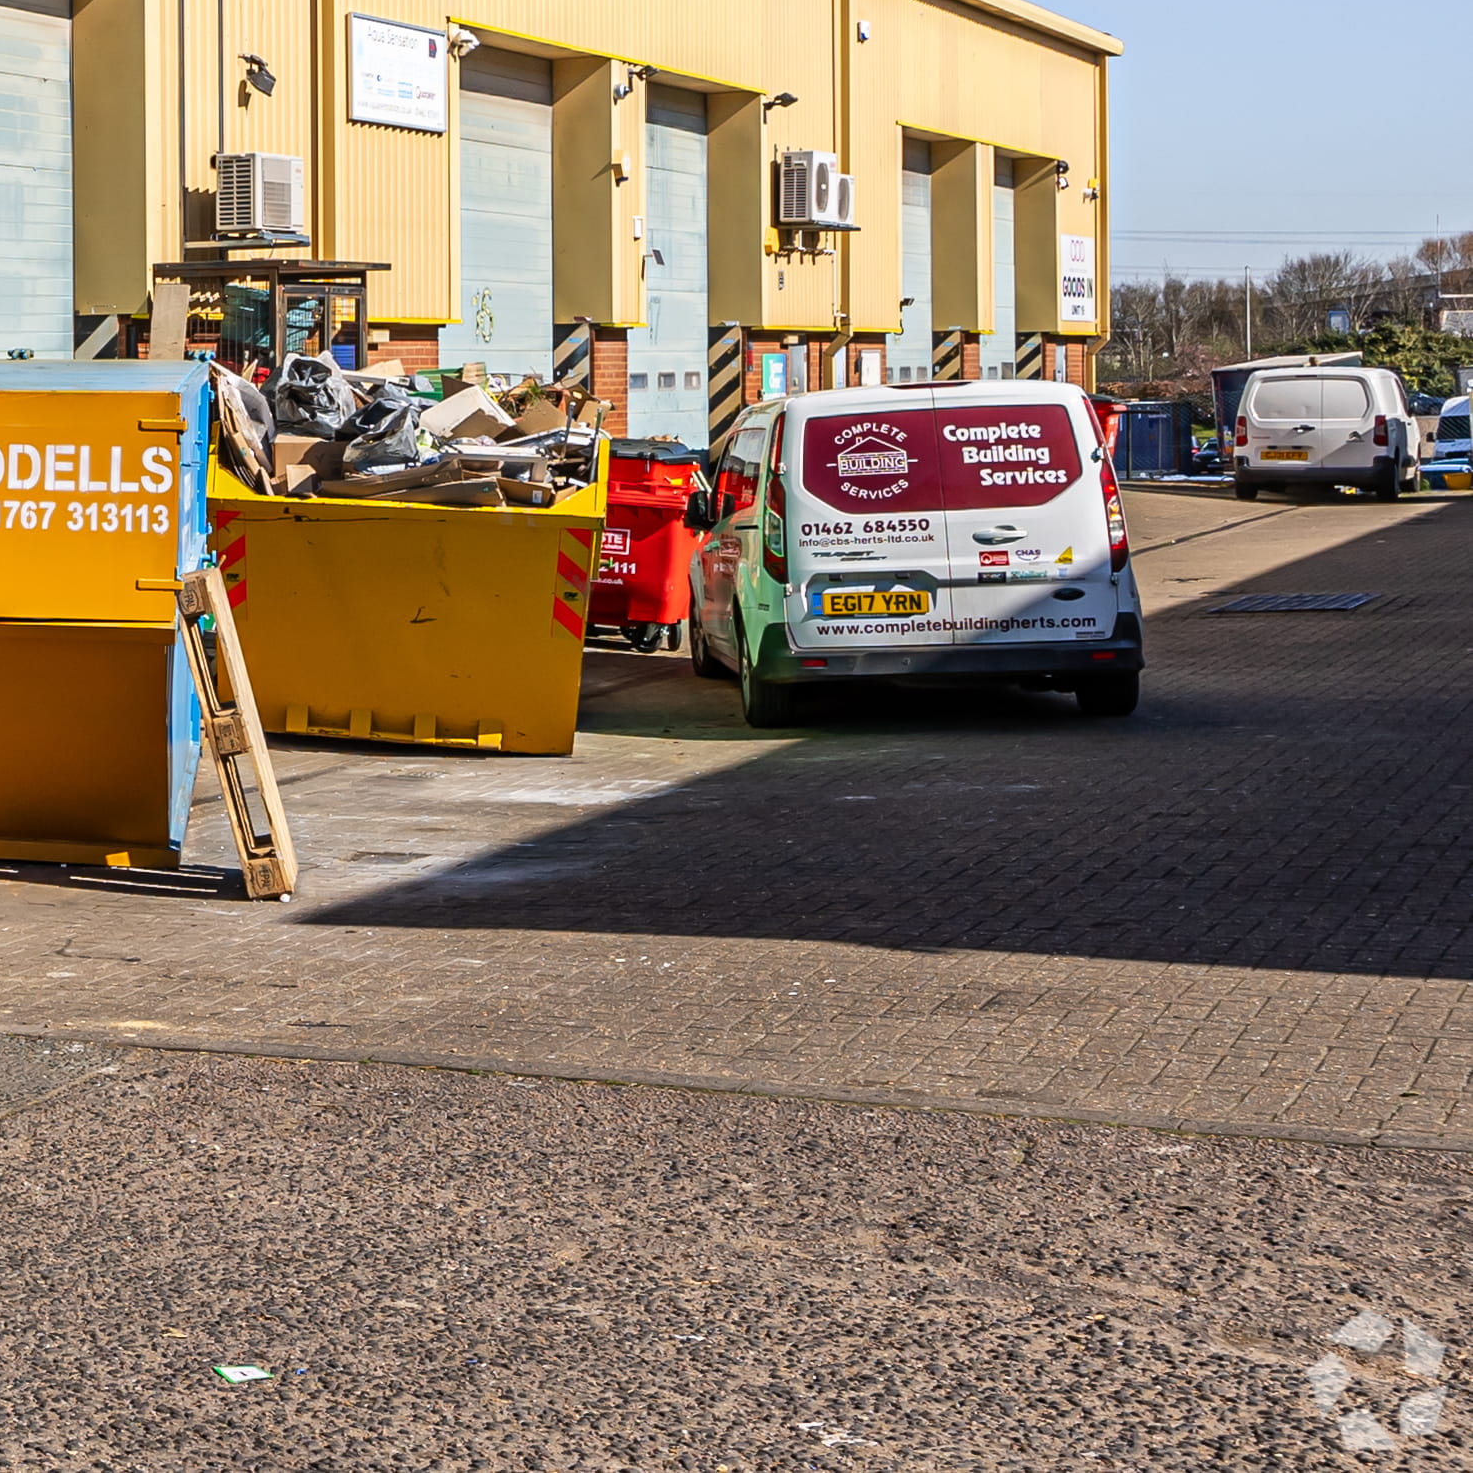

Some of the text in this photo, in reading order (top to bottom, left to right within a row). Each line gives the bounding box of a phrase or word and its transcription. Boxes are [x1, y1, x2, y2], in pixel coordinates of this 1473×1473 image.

[834, 422, 908, 445] COMPLETE
[943, 422, 1041, 443] Complete
[841, 456, 905, 470] BUILDING
[962, 444, 1050, 464] Building
[980, 467, 1067, 486] Services
[840, 478, 908, 500] SERVICES
[67, 501, 170, 534] 313113
[801, 519, 930, 536] 01462 684550
[799, 534, 935, 547] info@cbs-herts-ltd.co.uk
[830, 594, 922, 612] EG17 YRN
[817, 615, 1096, 636] www.completebuildingherts.com
